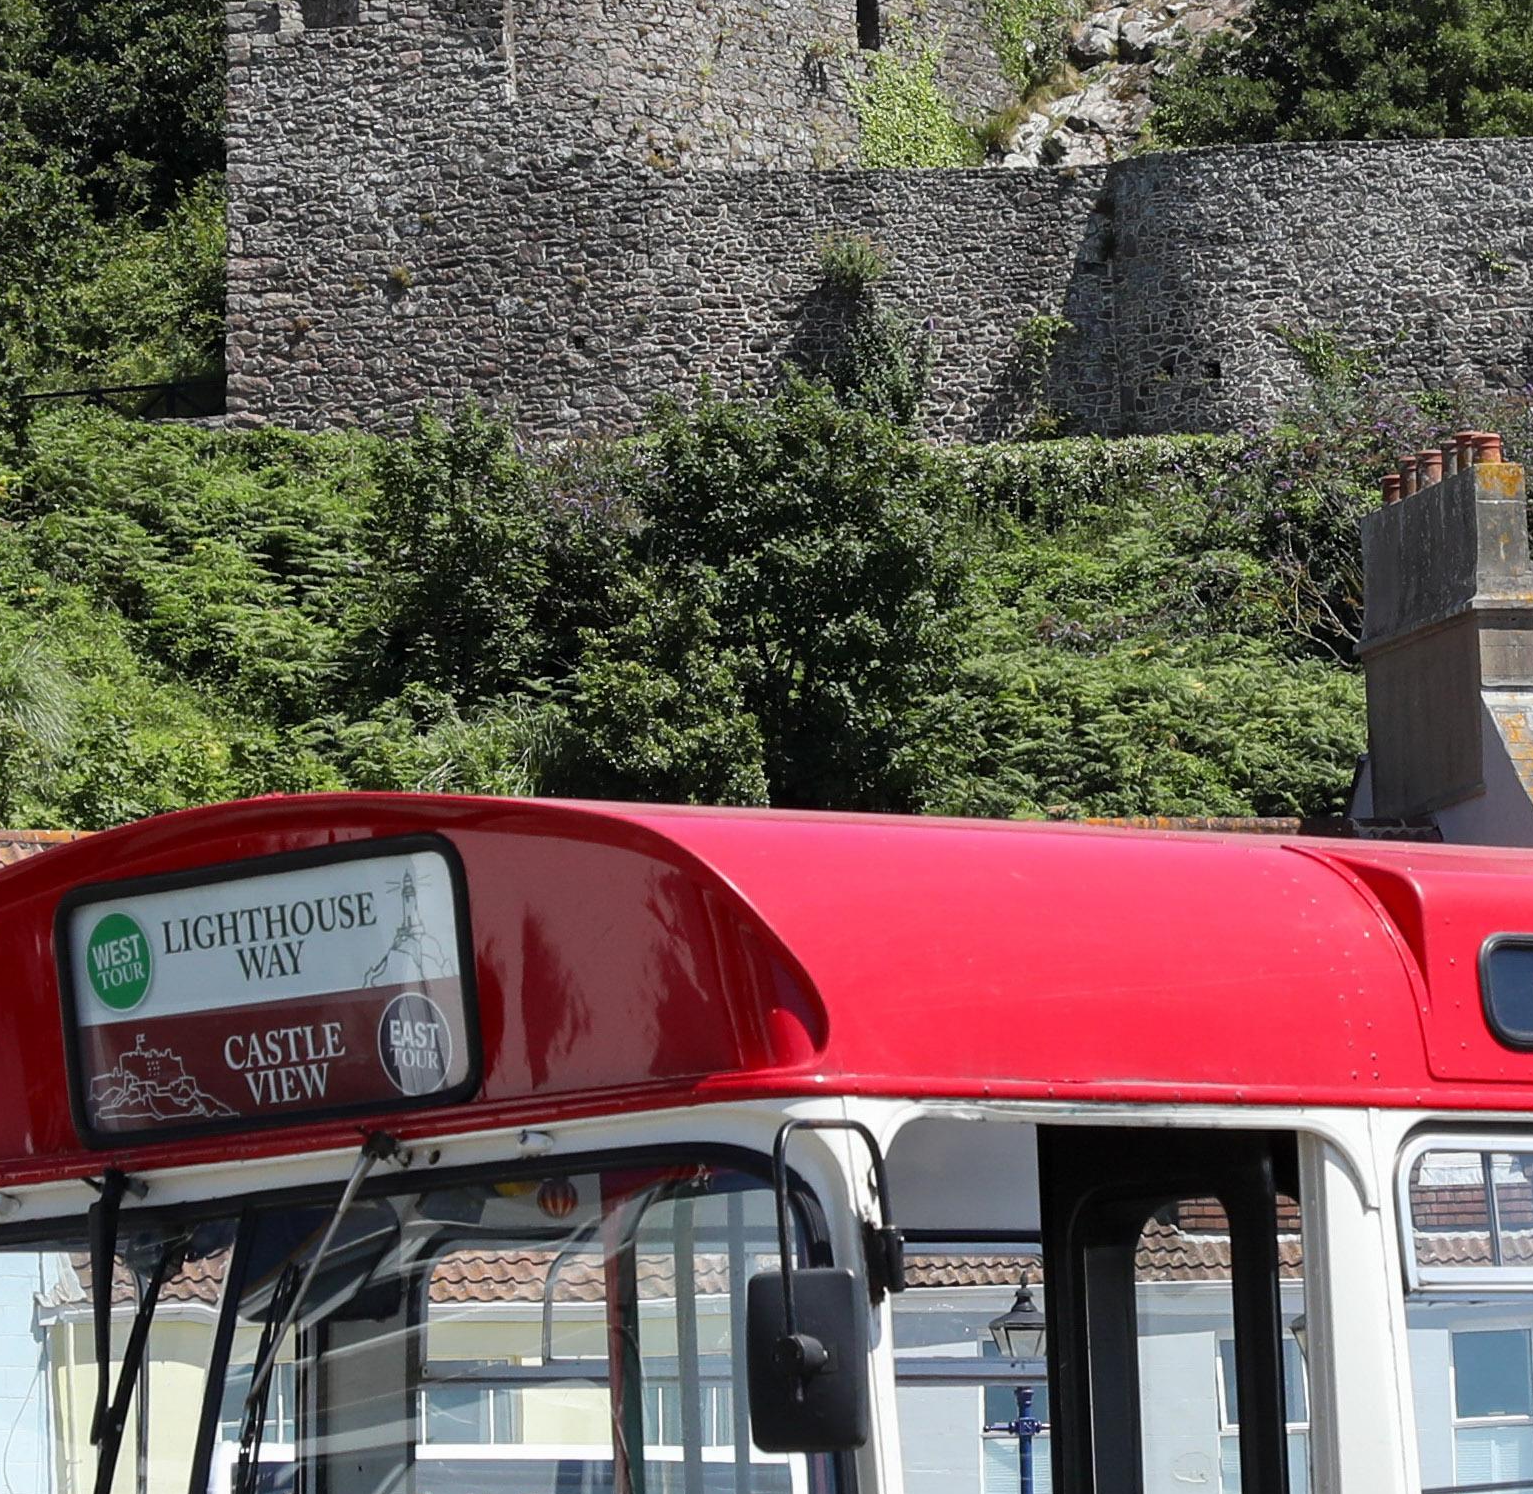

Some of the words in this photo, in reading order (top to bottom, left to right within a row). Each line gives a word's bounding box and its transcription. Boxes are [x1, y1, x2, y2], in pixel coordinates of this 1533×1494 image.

[162, 891, 377, 955] LIGHTHOUSE
[92, 935, 140, 971] WEST
[238, 940, 306, 981] WAY
[97, 961, 145, 989] TOUR
[224, 1022, 345, 1071] CASTLE
[390, 1019, 438, 1050] EAST
[390, 1046, 438, 1071] TOUR
[246, 1063, 328, 1105] VIEW
